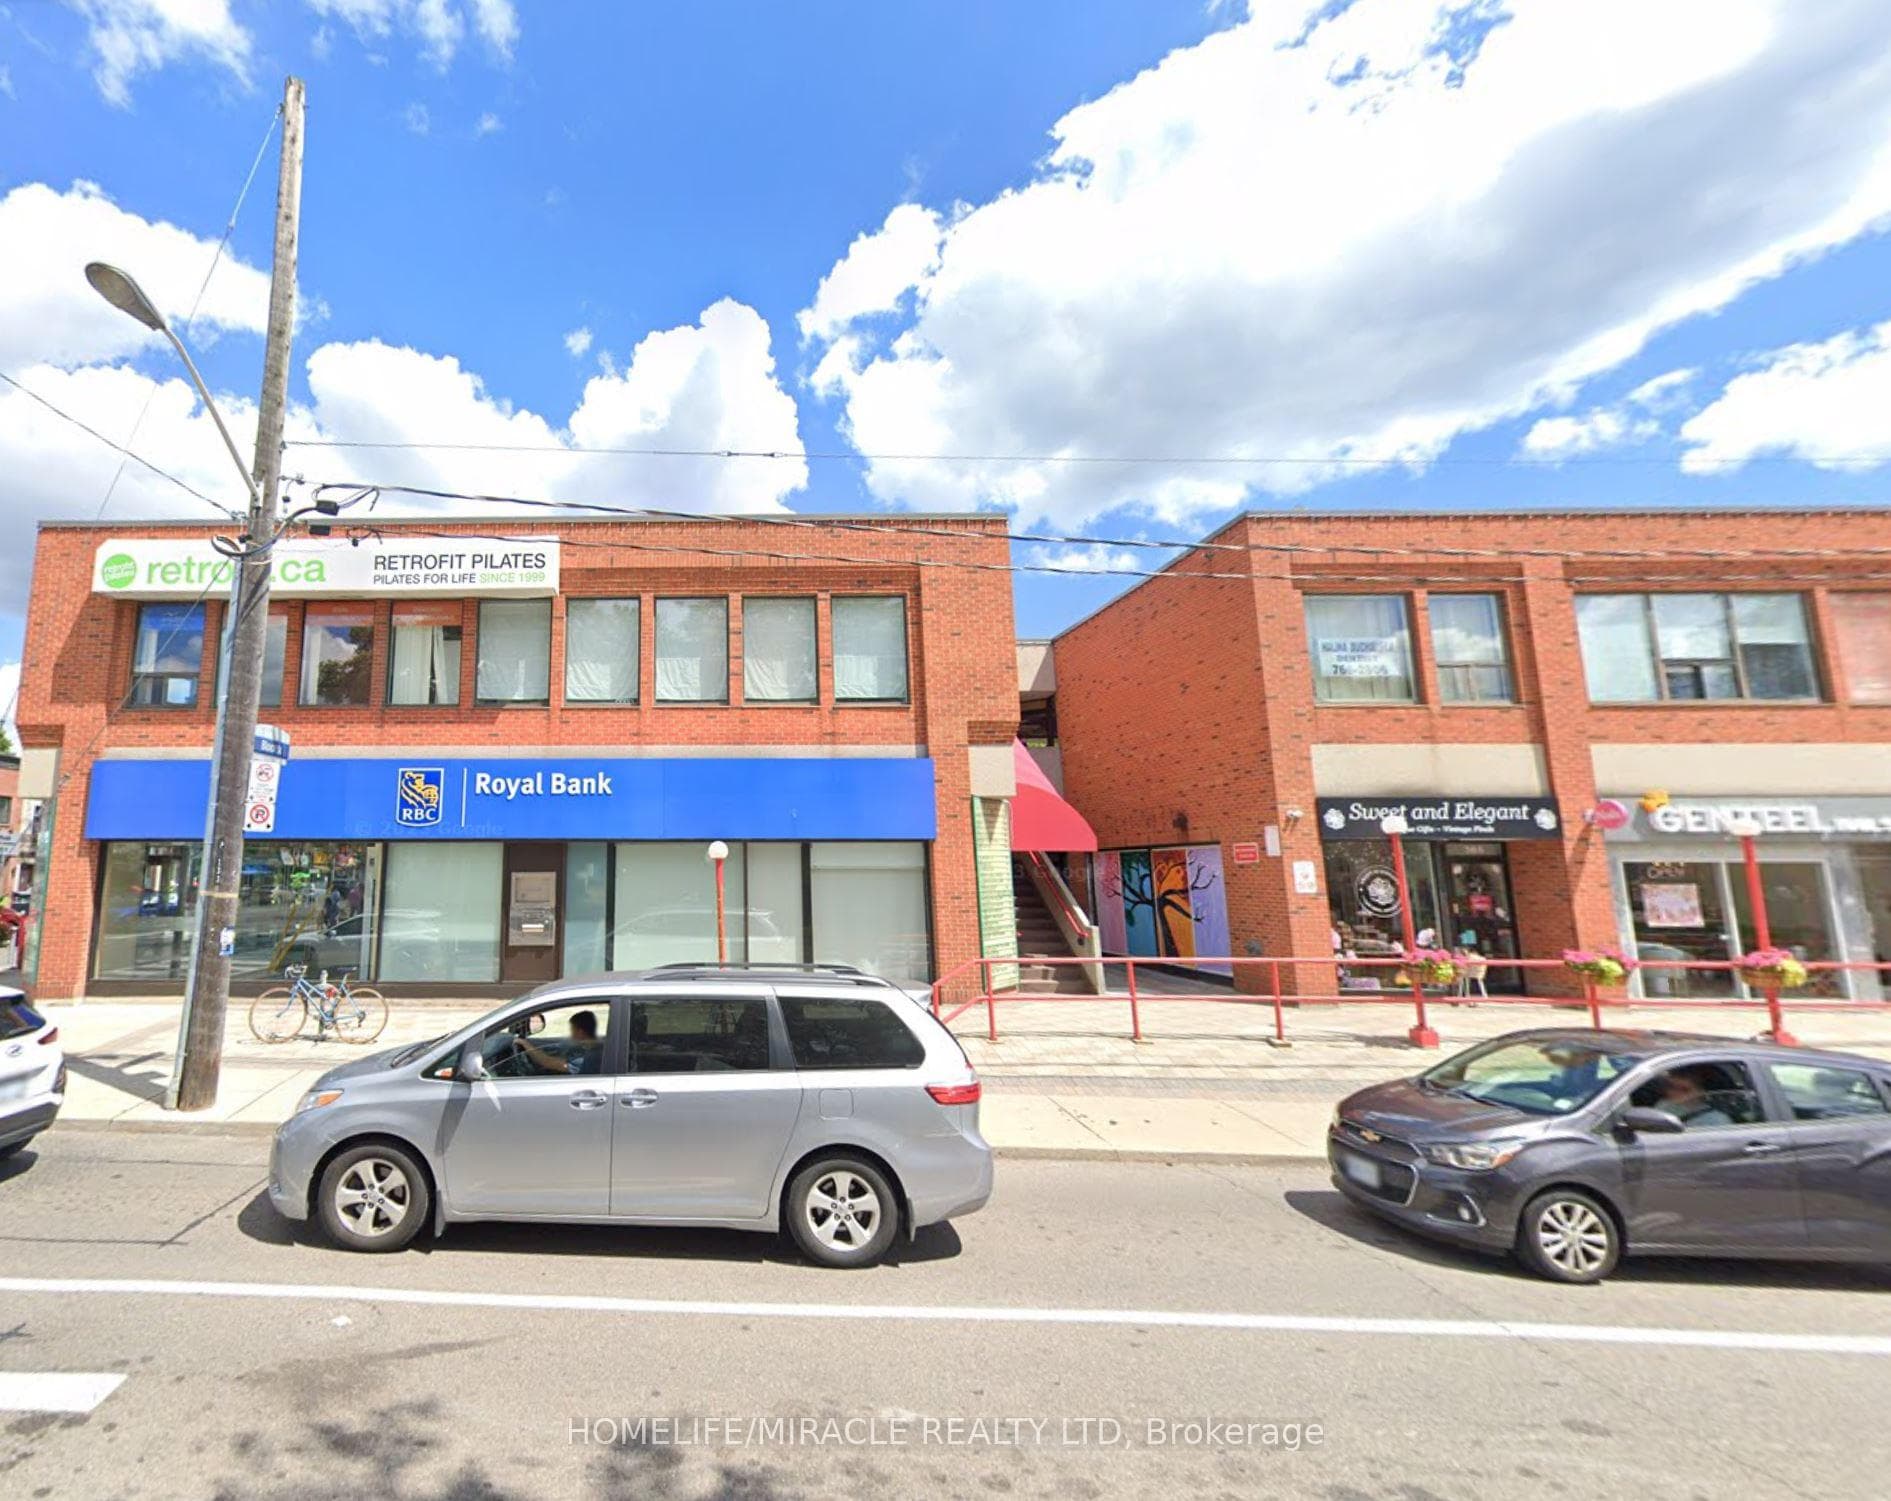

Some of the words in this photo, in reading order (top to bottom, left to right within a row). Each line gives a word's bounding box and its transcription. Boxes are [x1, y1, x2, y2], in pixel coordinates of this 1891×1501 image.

[147, 556, 326, 585] retro.ca
[374, 554, 466, 571] RETROFIT
[472, 553, 546, 569] PILATES
[373, 574, 421, 585] PILATES
[423, 573, 449, 584] FOR
[451, 573, 477, 584] LIFE
[480, 572, 515, 583] SINCE
[519, 571, 546, 583] 1999
[475, 771, 544, 800] Royal
[551, 771, 613, 795] Bank
[402, 808, 437, 822] RBC
[1348, 802, 1407, 822] Sweet
[1410, 802, 1450, 821] and
[1453, 802, 1530, 824] Elegant
